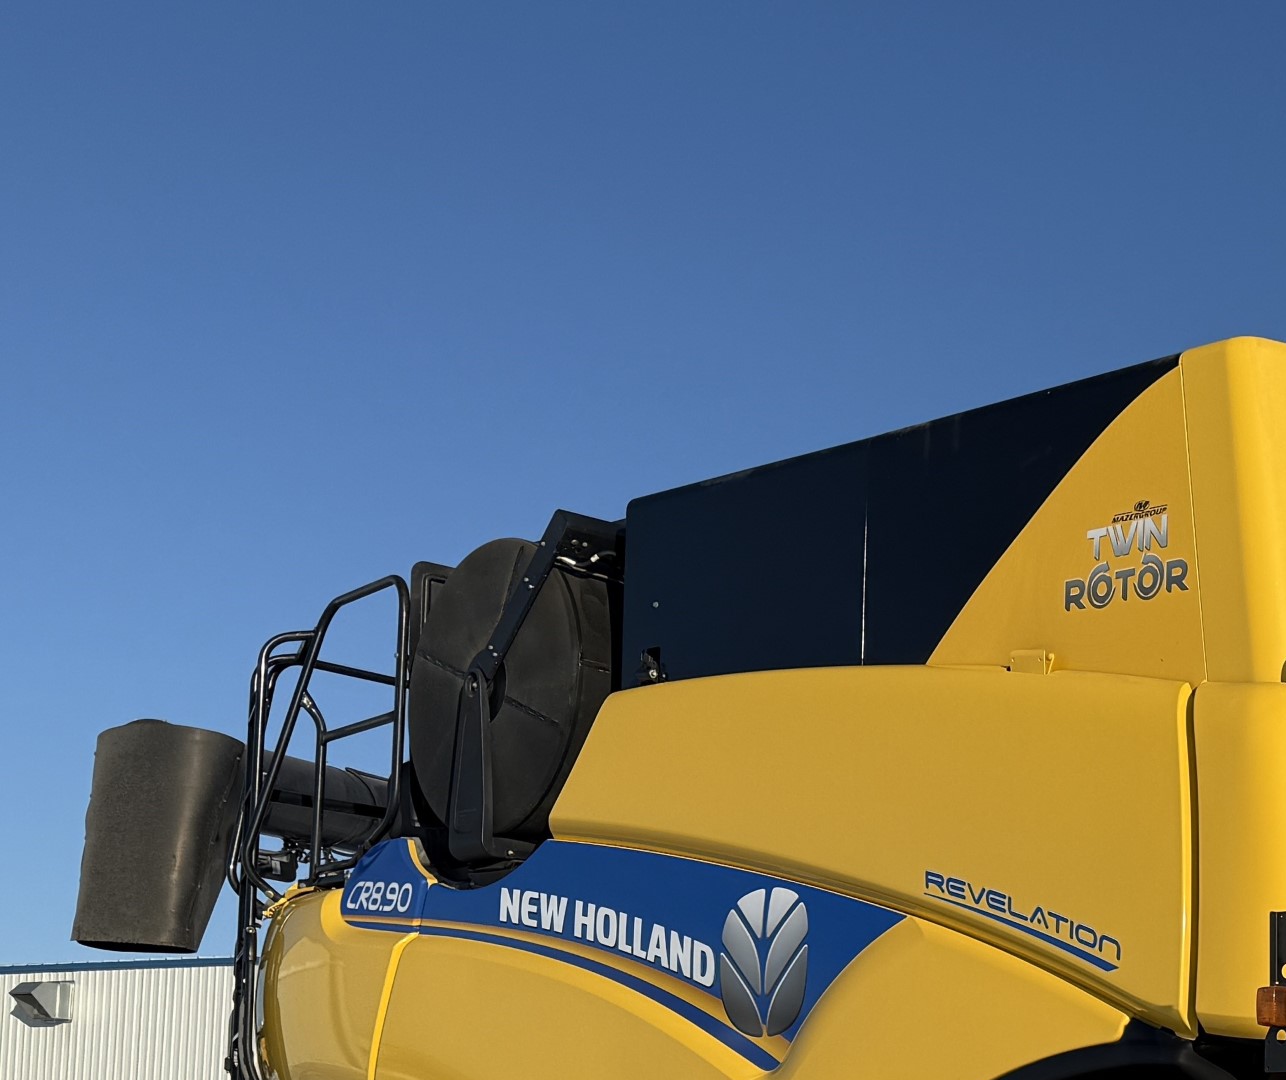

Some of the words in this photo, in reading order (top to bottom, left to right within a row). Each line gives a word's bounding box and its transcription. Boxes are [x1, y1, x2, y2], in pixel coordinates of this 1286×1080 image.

[1087, 514, 1168, 561] TWIN
[1064, 552, 1189, 612] ROTOR
[346, 881, 413, 913] CR8.90
[924, 870, 1121, 961] REVELATION
[499, 887, 569, 933] NEW
[573, 900, 716, 988] HOLLAND
